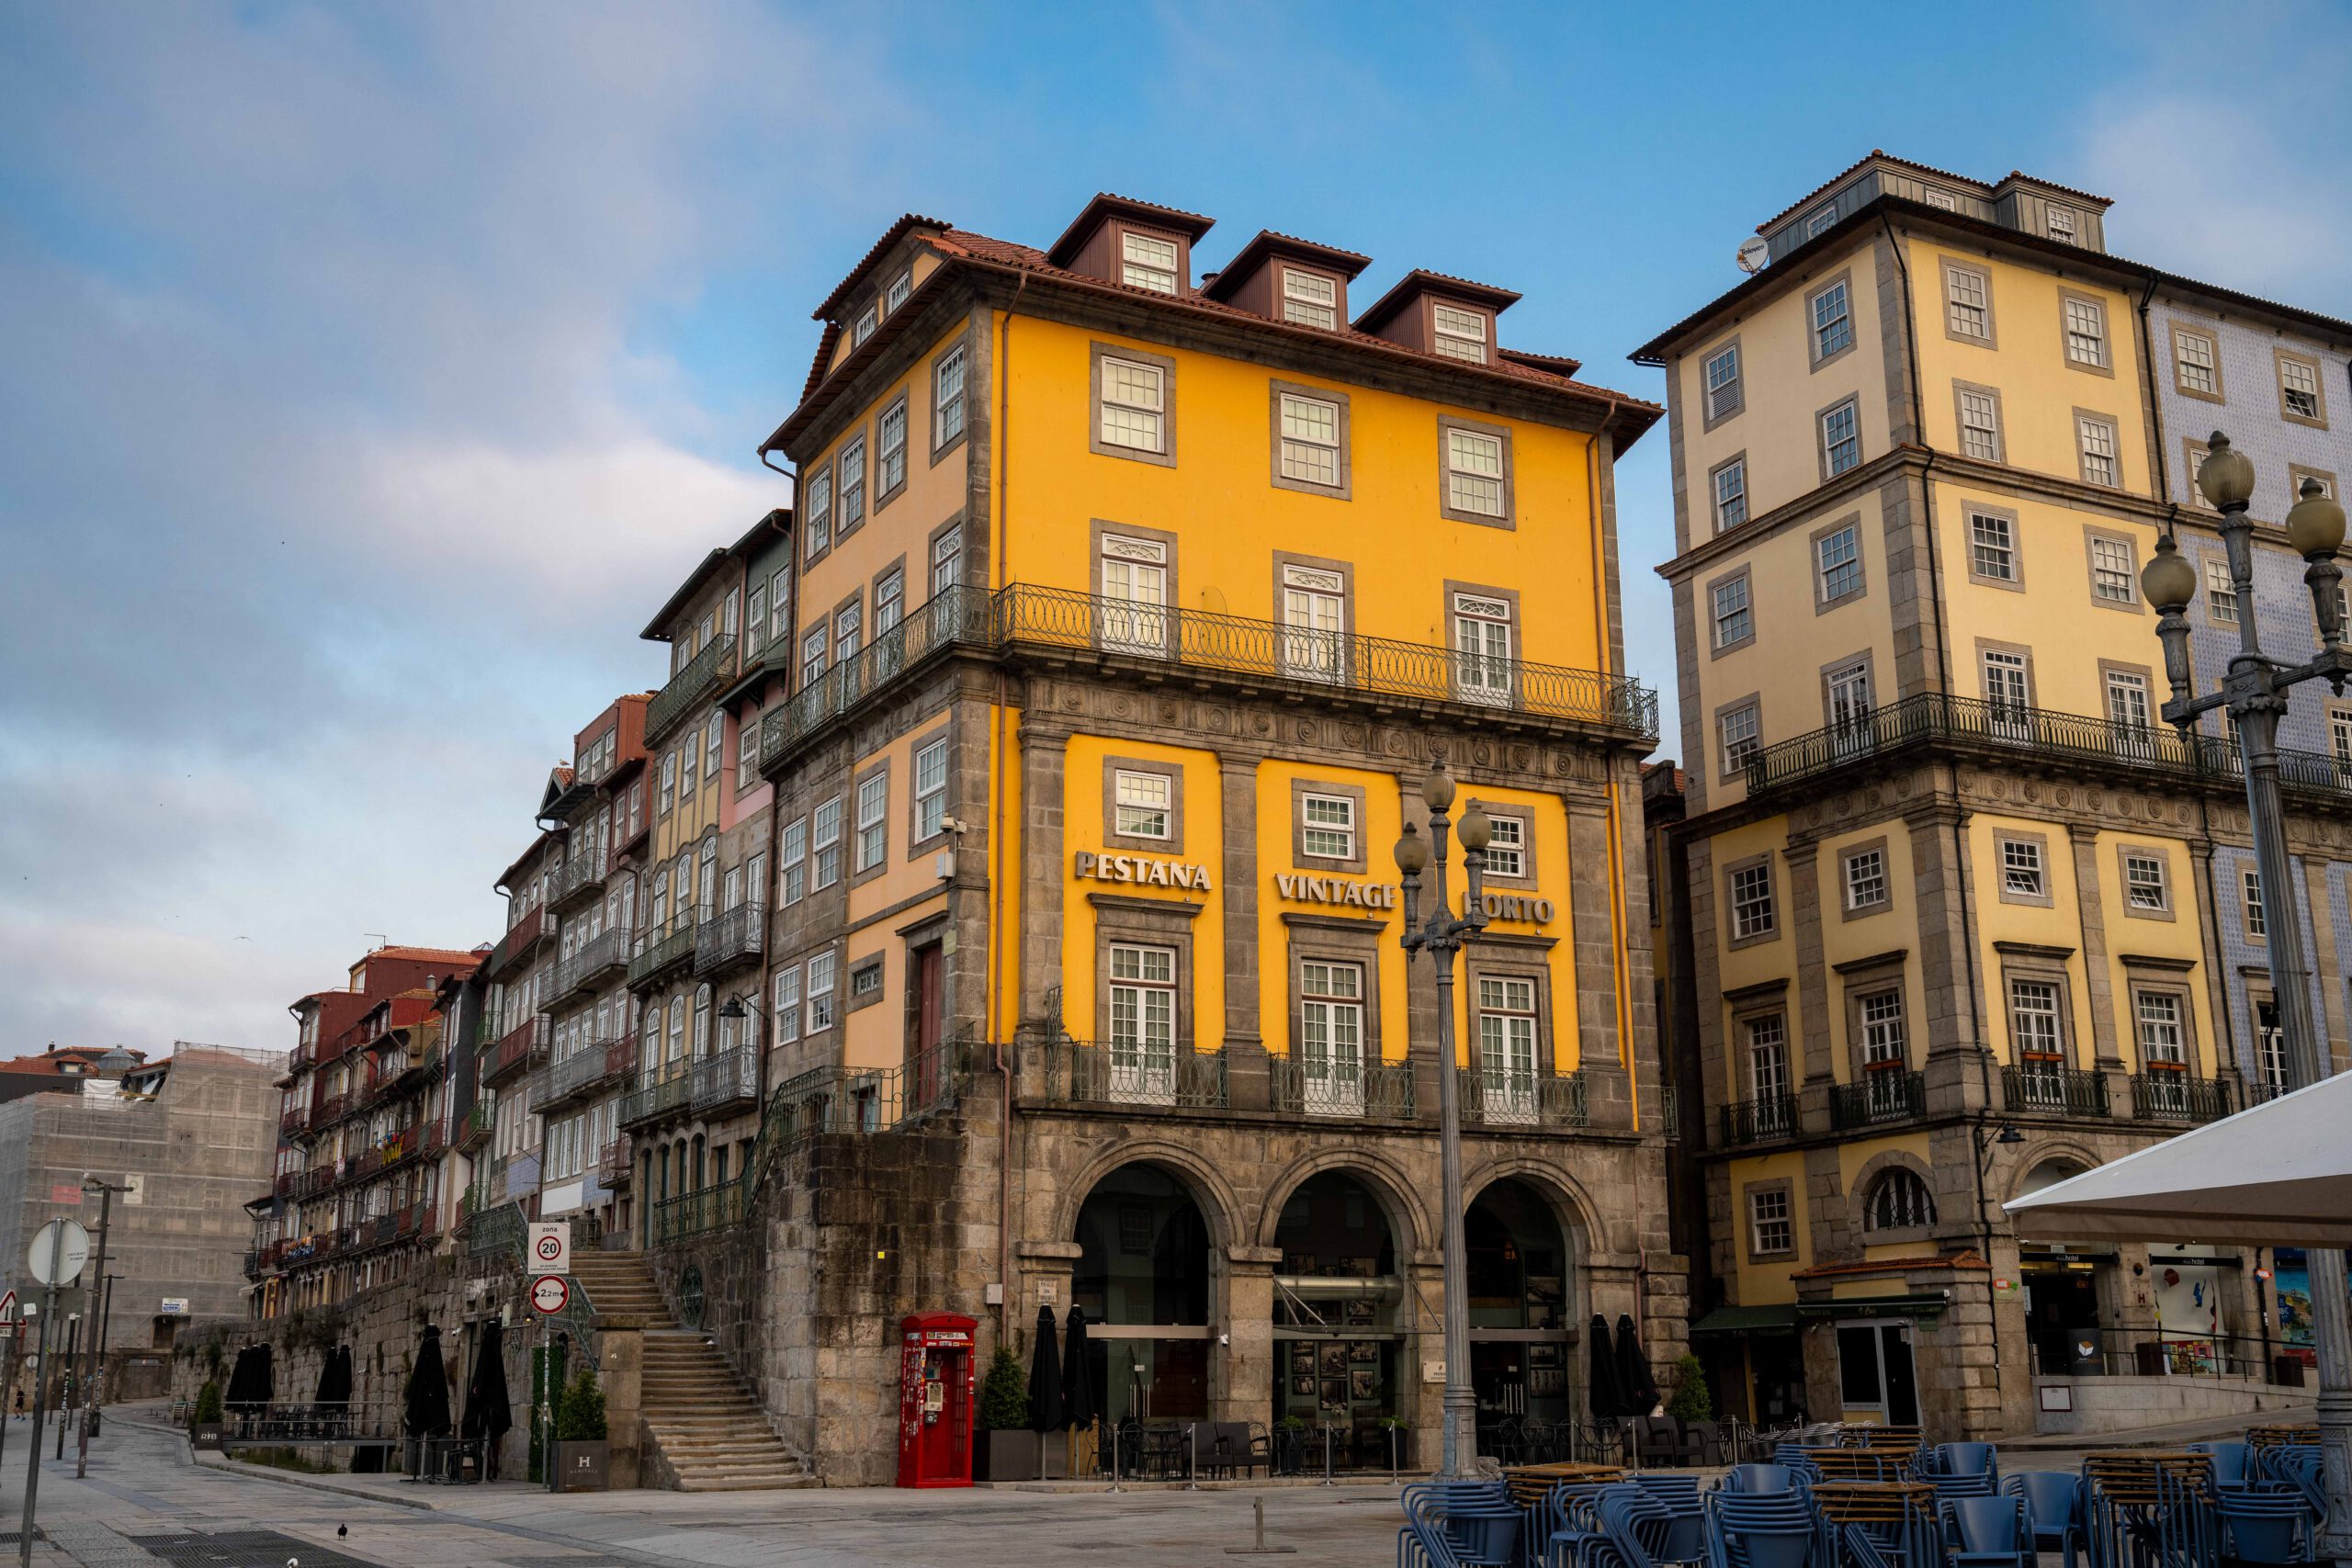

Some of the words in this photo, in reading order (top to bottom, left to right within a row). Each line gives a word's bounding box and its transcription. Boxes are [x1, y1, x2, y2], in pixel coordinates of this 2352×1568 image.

[1076, 851, 1212, 890] PESTANA
[1275, 873, 1396, 908] VINTAGE
[542, 1243, 557, 1254] 20
